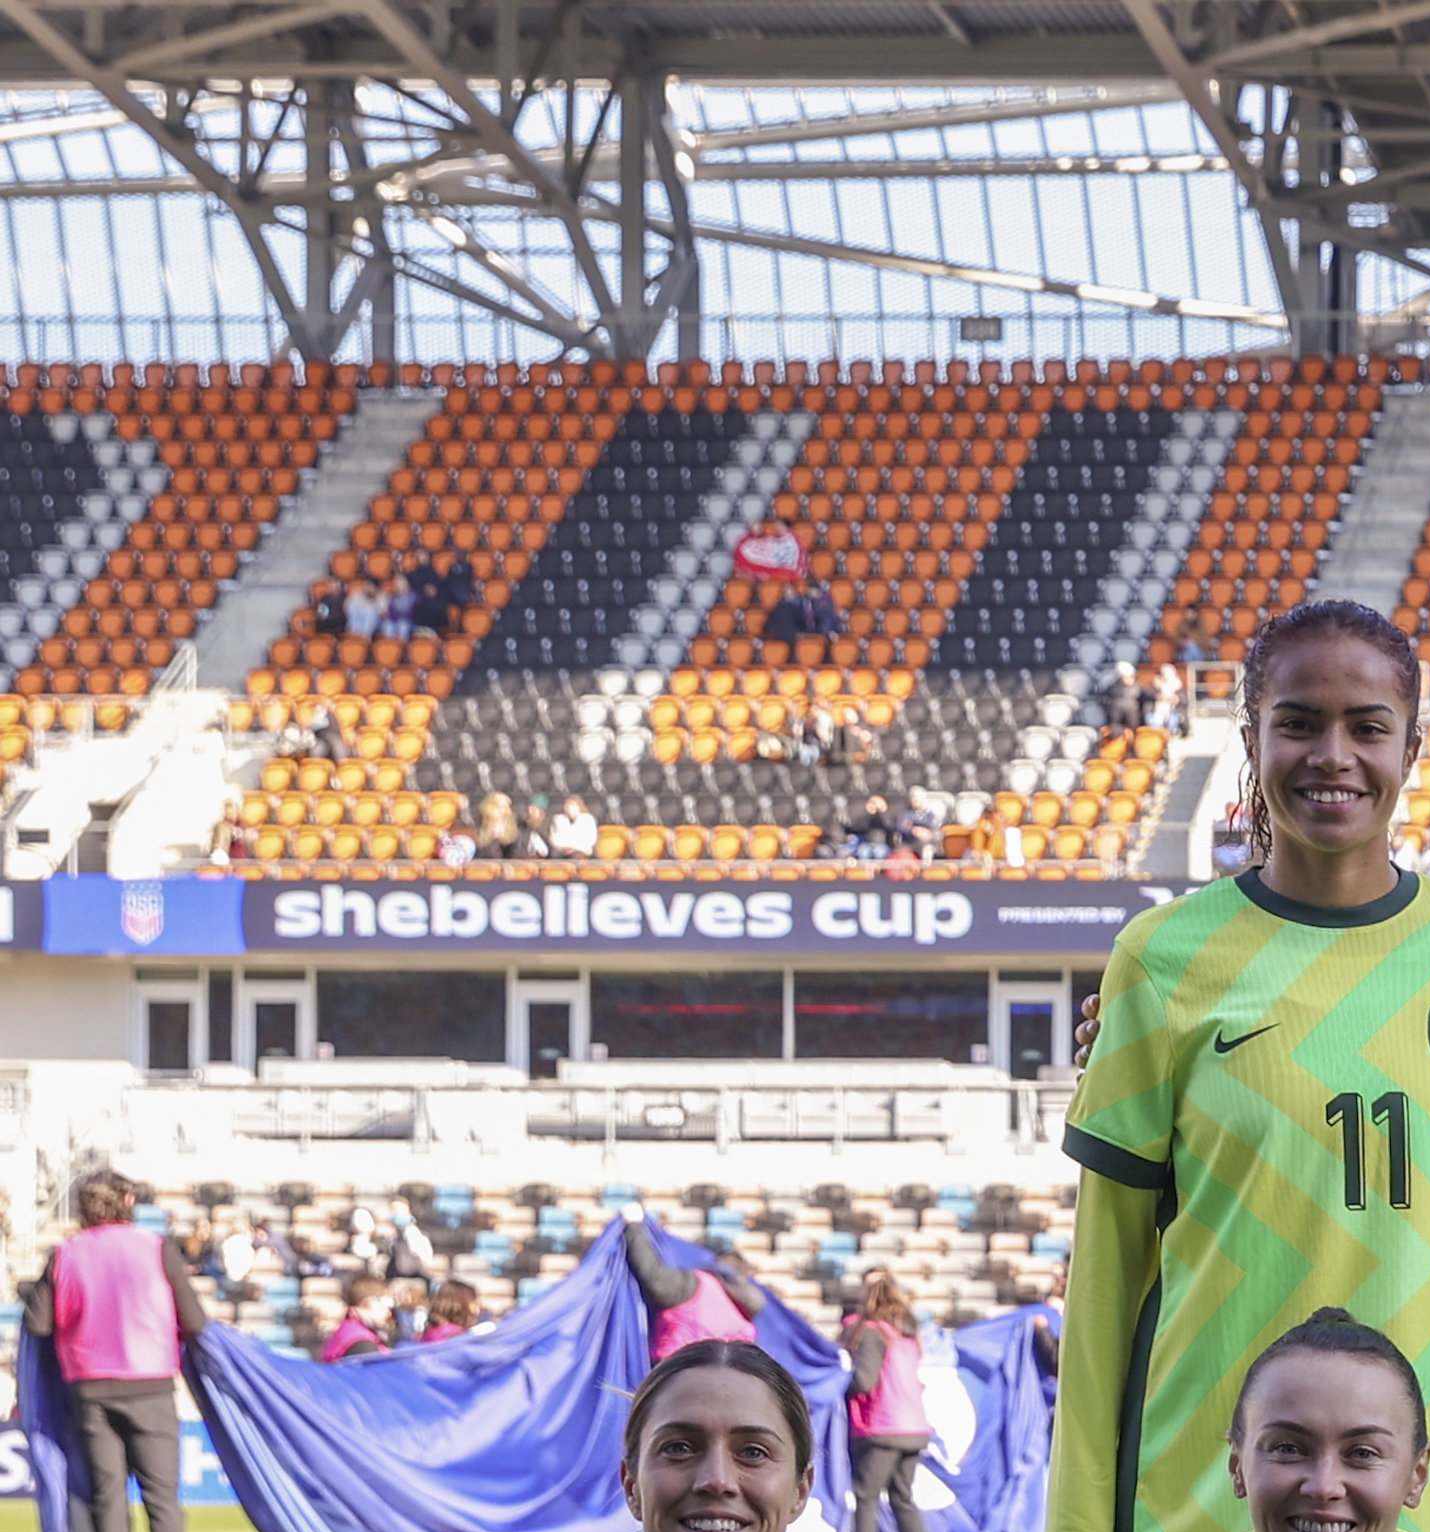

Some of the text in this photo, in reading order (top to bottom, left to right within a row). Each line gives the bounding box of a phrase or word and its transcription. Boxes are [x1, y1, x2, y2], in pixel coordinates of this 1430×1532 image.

[274, 883, 793, 938] shebelieves
[811, 891, 974, 945] cup
[1326, 1092, 1411, 1210] 11
